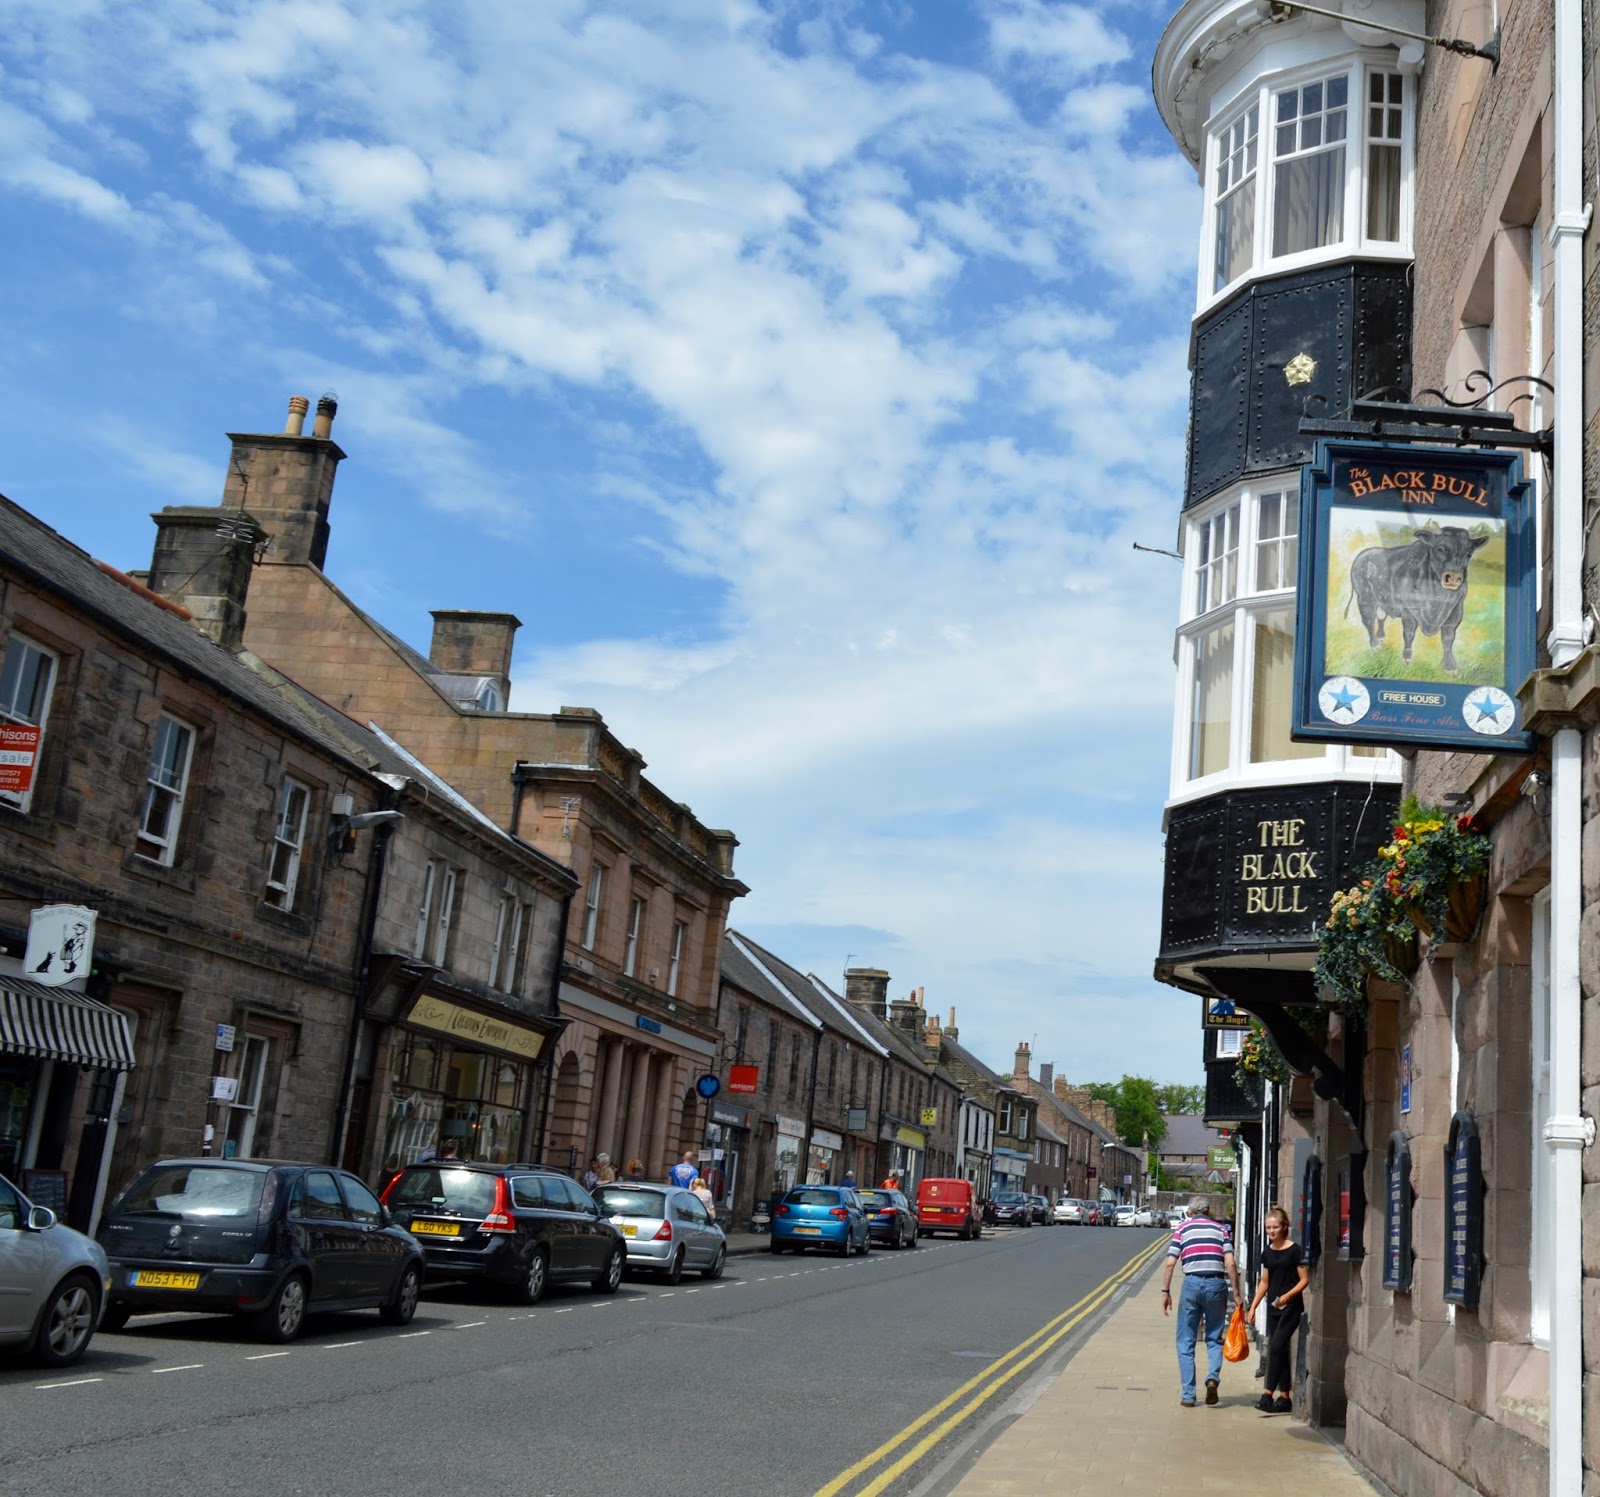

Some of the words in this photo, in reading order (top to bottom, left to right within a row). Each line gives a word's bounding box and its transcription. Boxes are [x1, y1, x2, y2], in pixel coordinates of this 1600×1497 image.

[1349, 468, 1369, 479] The
[1349, 471, 1427, 498] BLACK
[1432, 473, 1489, 507] BULL
[1401, 489, 1435, 504] INN
[1383, 693, 1407, 702] FREE
[1409, 694, 1440, 704] HOUSE
[1367, 710, 1397, 723] Bass
[1401, 712, 1430, 725] Fine
[1432, 714, 1460, 727] Ales
[2, 754, 29, 763] sale
[1257, 819, 1306, 847] THE
[1241, 851, 1318, 880] BLACK
[1246, 886, 1308, 913] BULL
[1209, 1015, 1224, 1023] The
[1226, 1015, 1247, 1025] Angel
[139, 1271, 170, 1286] ND53
[171, 1273, 197, 1287] FYH
